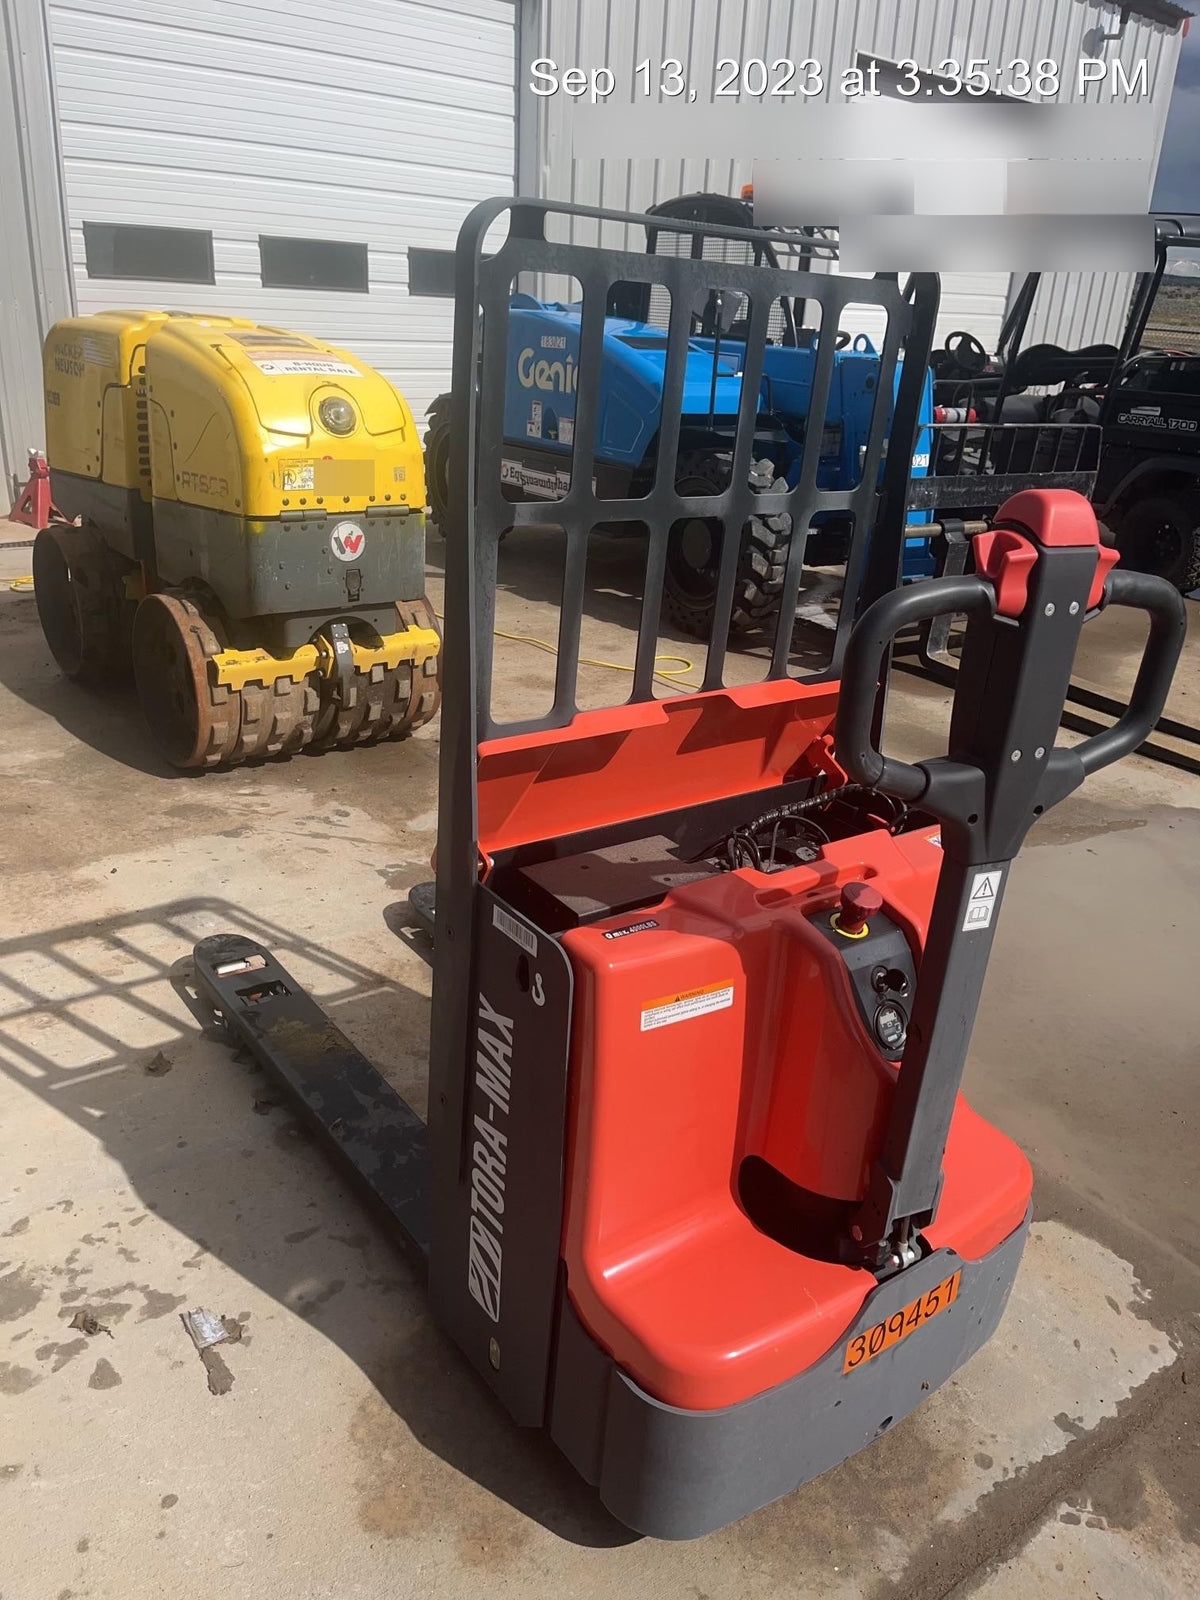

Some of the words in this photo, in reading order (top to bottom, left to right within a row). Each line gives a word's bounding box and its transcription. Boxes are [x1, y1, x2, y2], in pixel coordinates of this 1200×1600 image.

[1118, 412, 1167, 428] CARRYALL
[1168, 417, 1198, 431] 1700
[471, 991, 515, 1235] TORA-MAX
